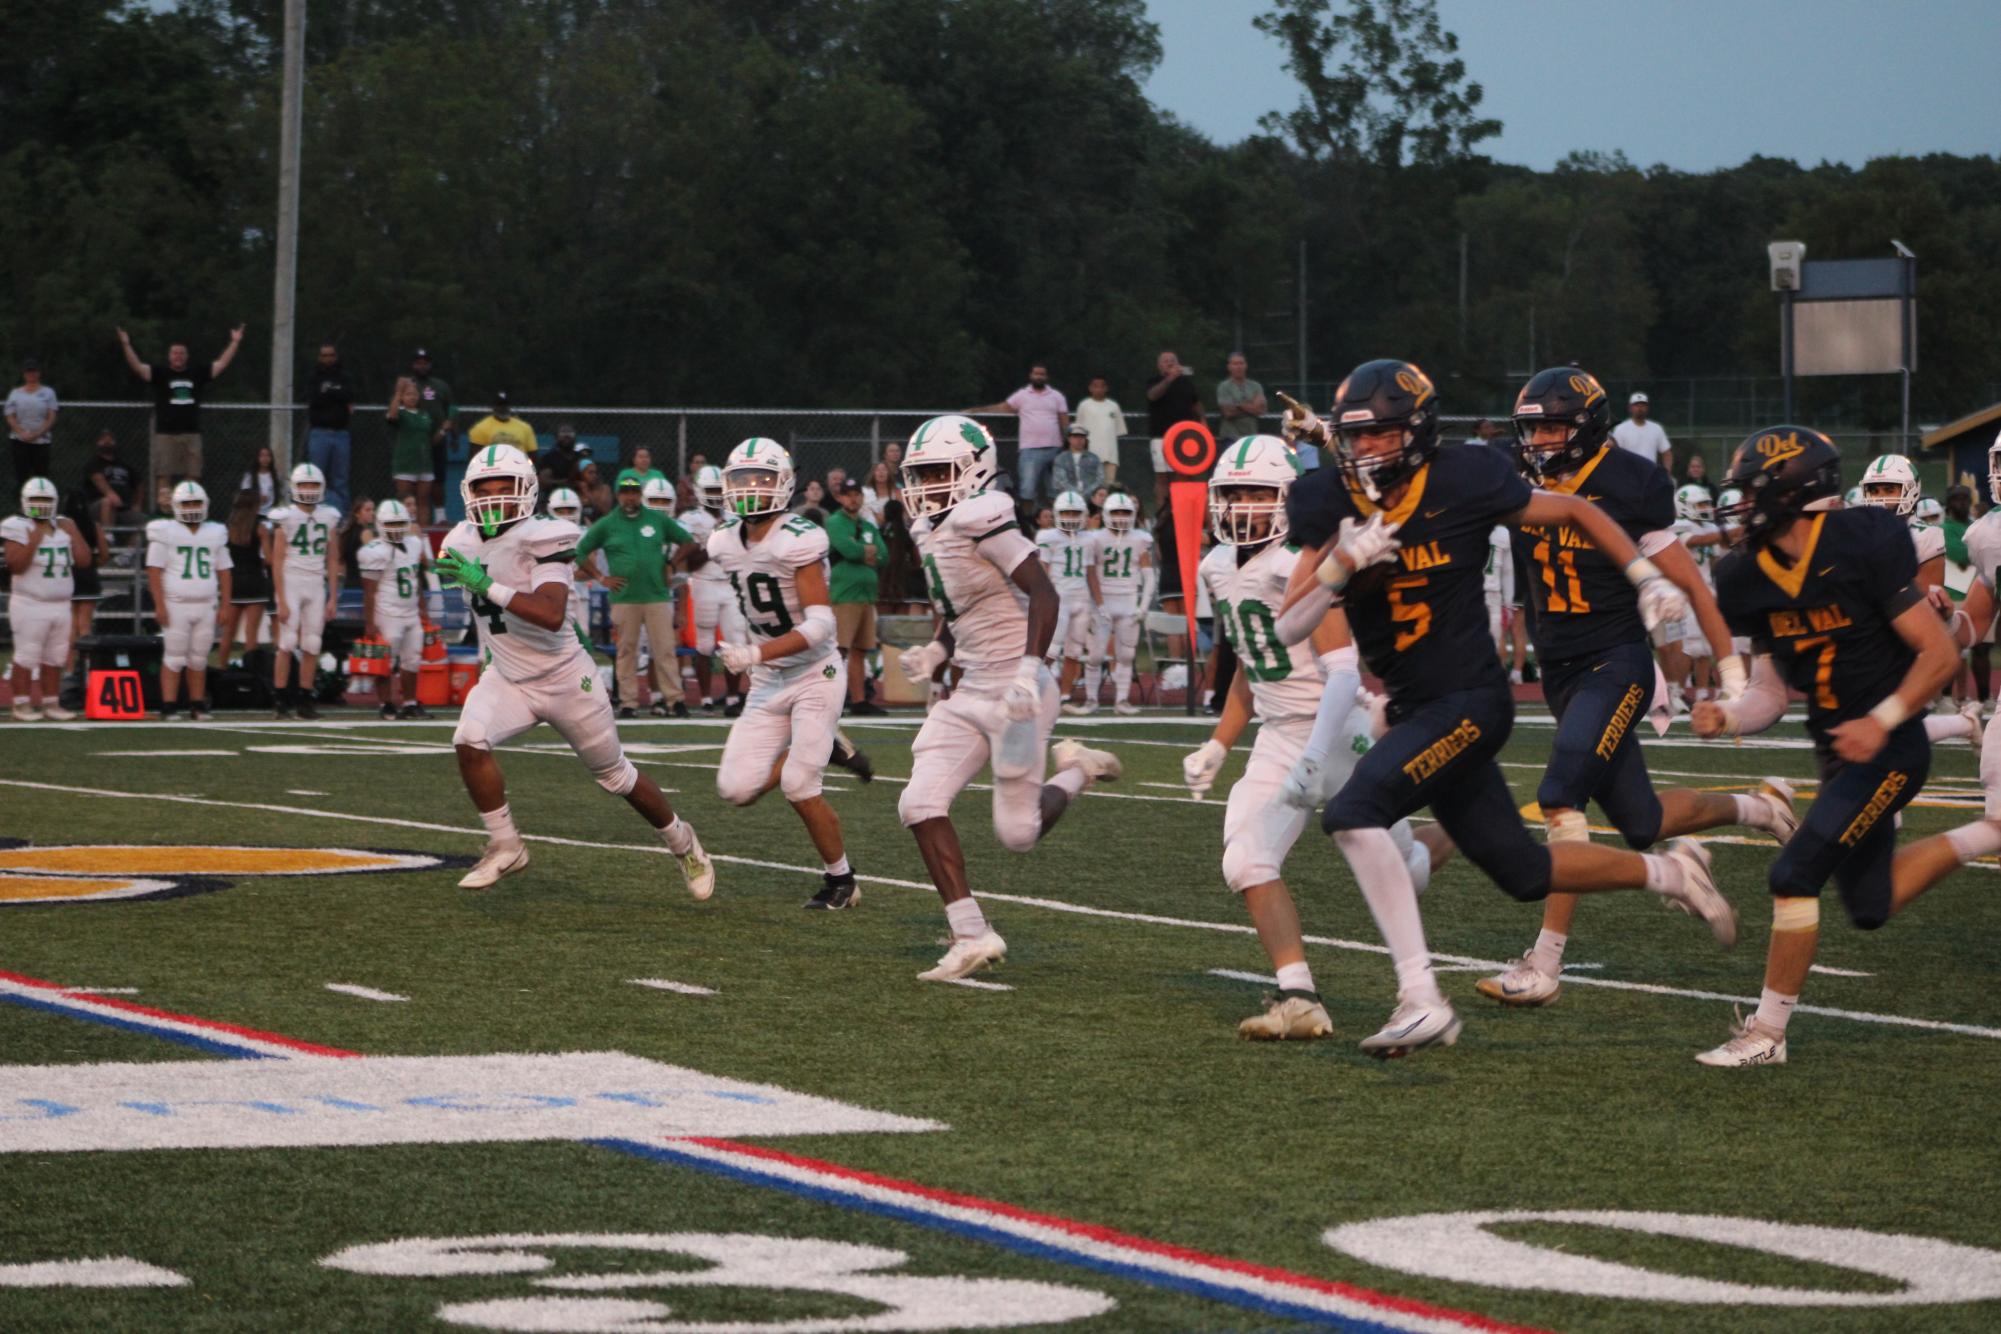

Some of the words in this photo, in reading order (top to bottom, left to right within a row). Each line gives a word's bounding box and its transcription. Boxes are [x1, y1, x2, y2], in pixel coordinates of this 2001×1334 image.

[1756, 431, 1802, 462] Del
[291, 523, 328, 556] 42
[1400, 541, 1452, 571] VAL
[38, 546, 70, 578] 77
[176, 546, 211, 579] 76
[1063, 546, 1084, 577] 11
[1103, 546, 1133, 577] 21
[1534, 540, 1591, 613] 11
[471, 564, 508, 635] 4
[730, 571, 795, 638] 19
[1388, 577, 1432, 652] 5
[1769, 610, 1808, 638] DEL
[1806, 603, 1852, 633] VAL
[1795, 636, 1839, 709] 7
[99, 676, 139, 715] 40
[1595, 683, 1645, 762] TERRIERS
[1402, 718, 1482, 785] TERRIERS
[1839, 771, 1908, 848] TERRIERS
